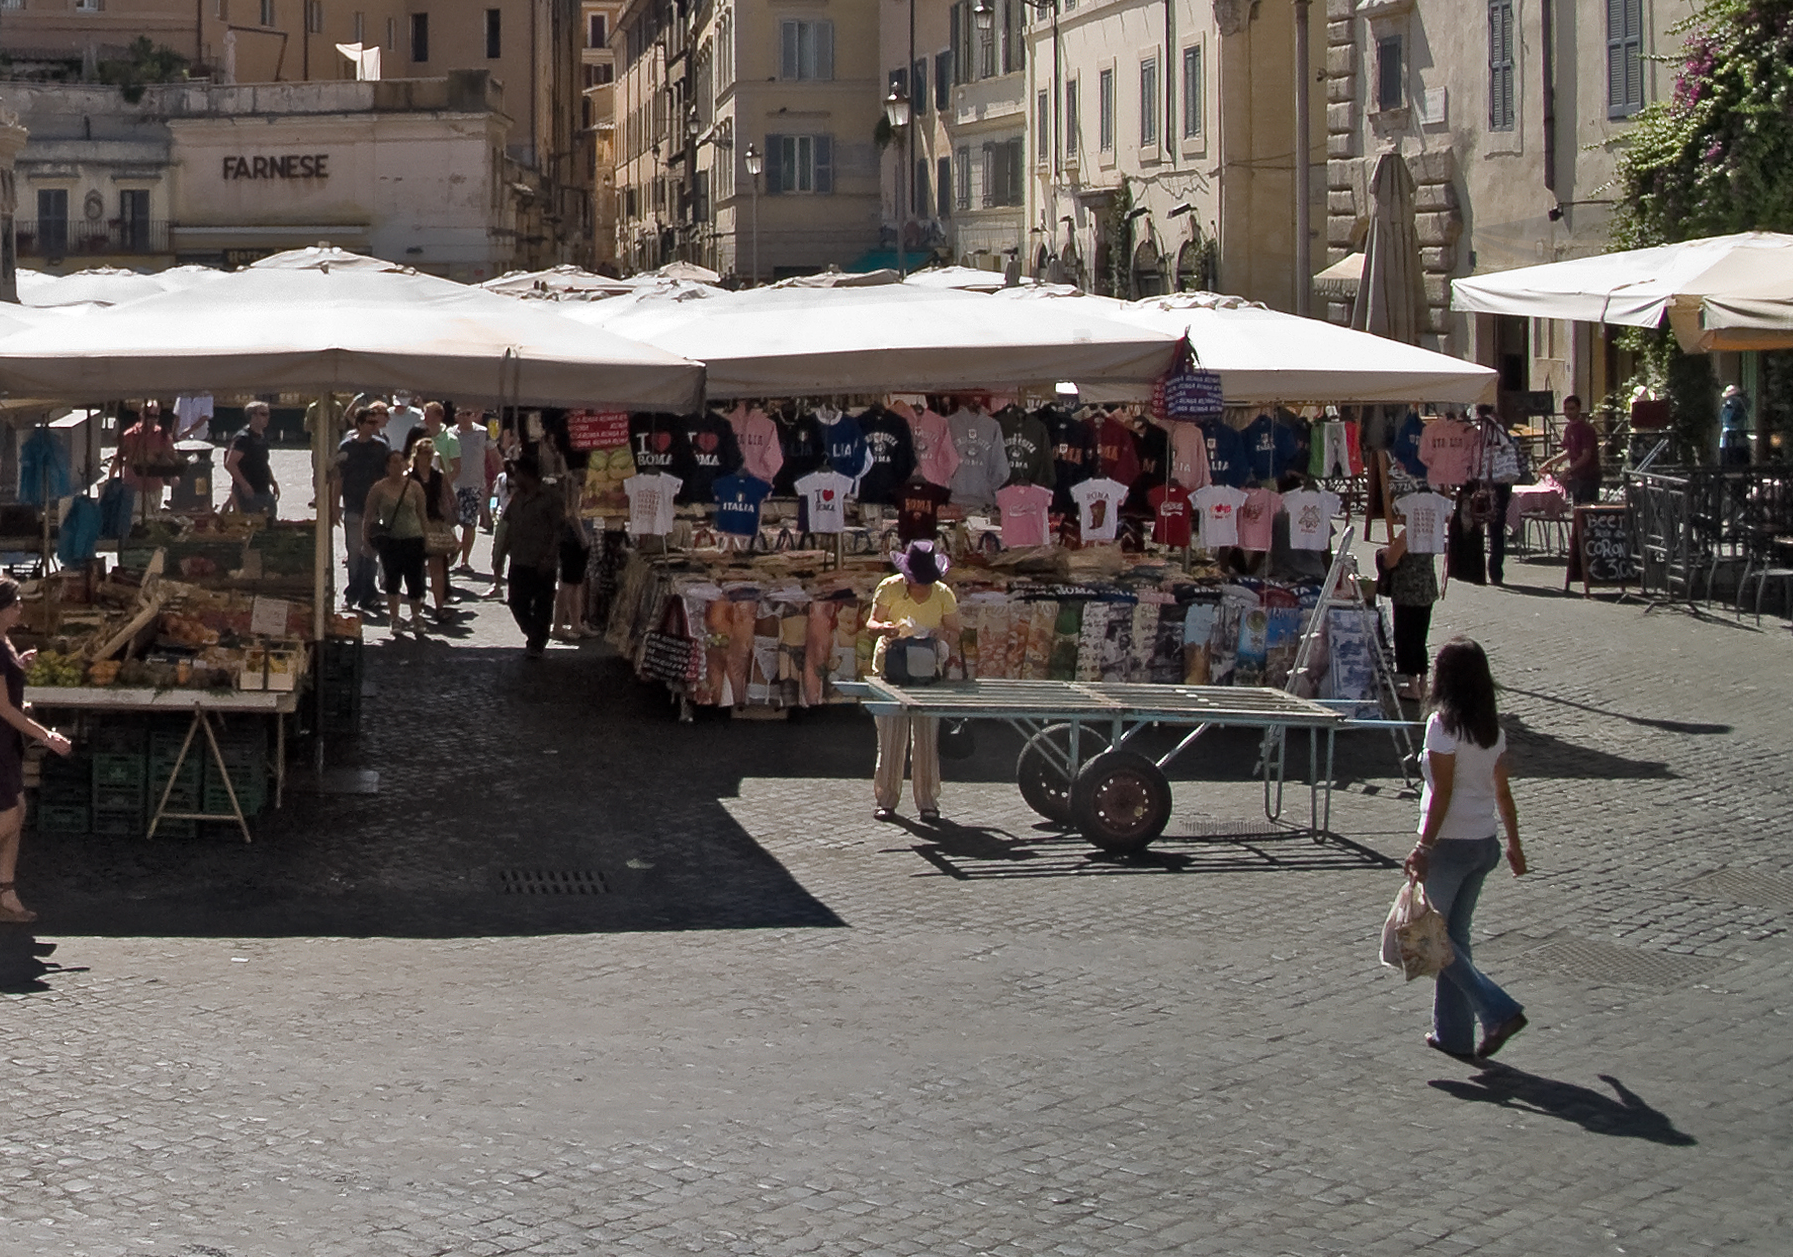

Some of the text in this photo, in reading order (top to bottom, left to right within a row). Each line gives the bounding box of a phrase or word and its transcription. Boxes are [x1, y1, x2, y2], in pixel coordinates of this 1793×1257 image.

[223, 154, 330, 180] FARNESE
[636, 432, 649, 455] I
[723, 502, 755, 513] ITALIA
[905, 497, 933, 515] ROMA
